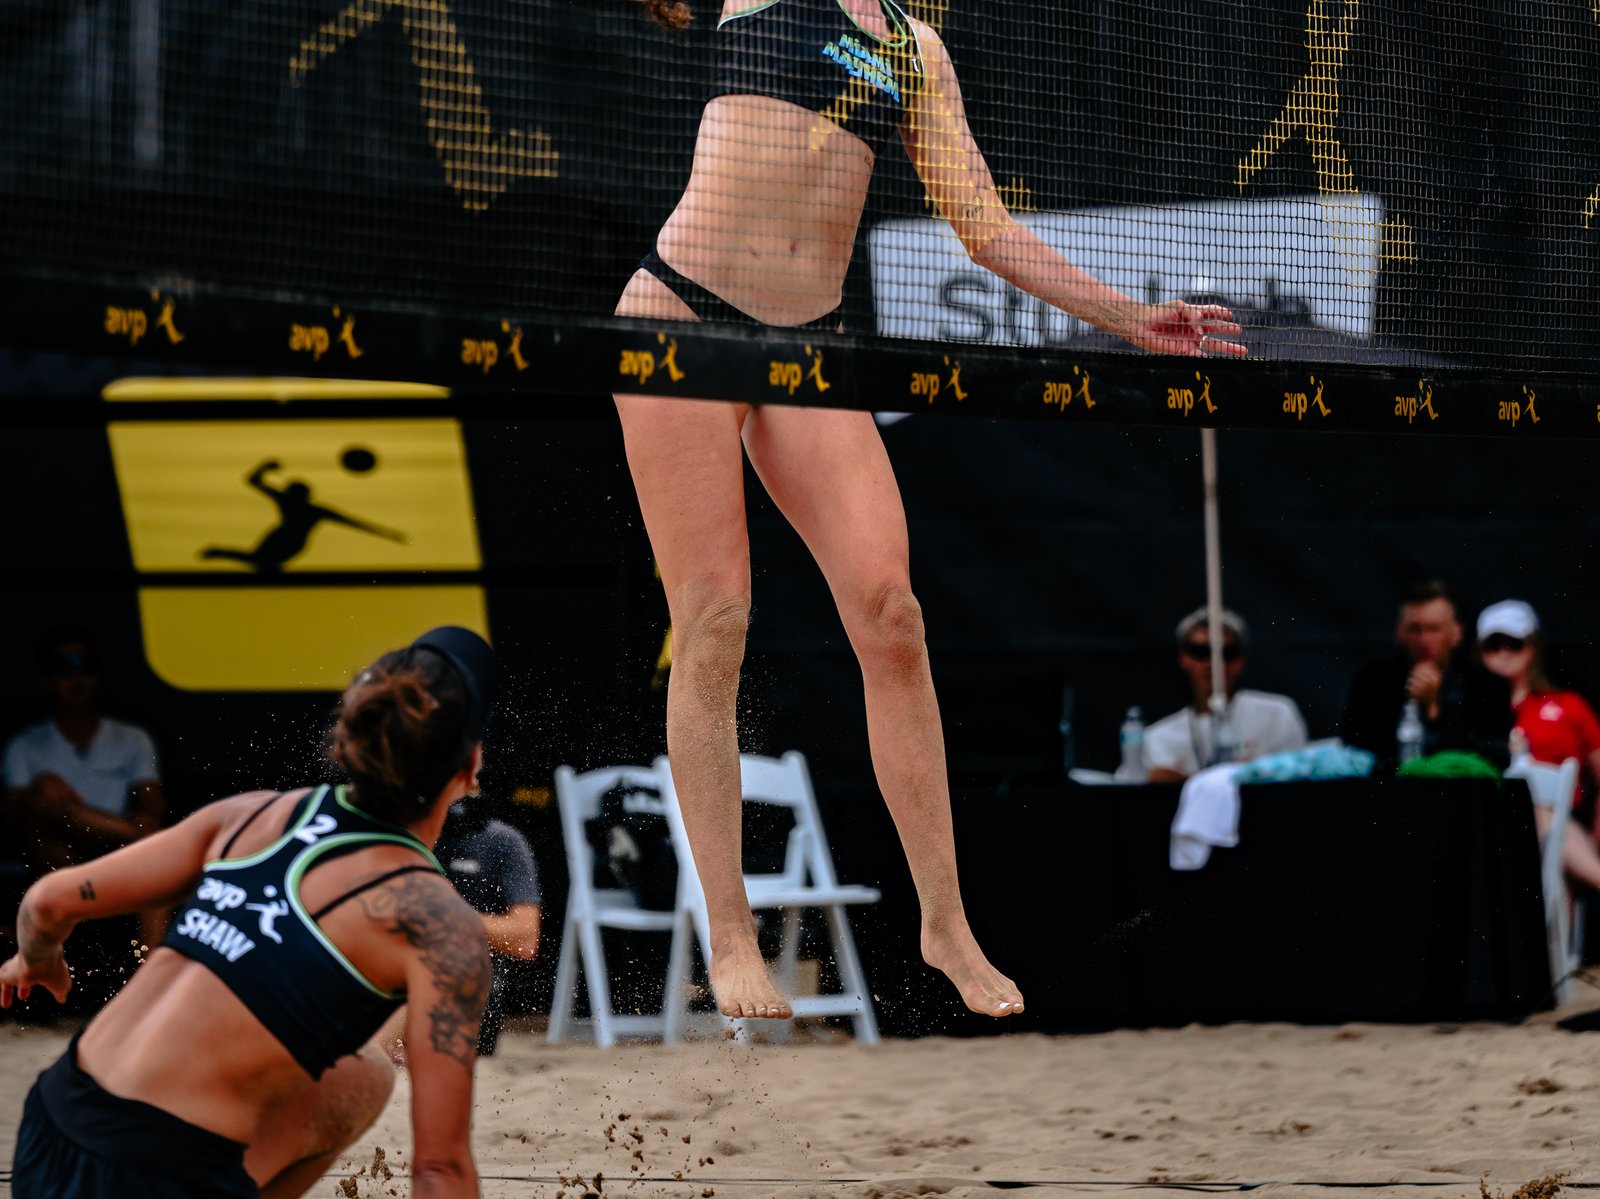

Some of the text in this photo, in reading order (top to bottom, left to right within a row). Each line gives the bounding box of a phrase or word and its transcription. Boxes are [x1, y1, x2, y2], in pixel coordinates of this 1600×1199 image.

[106, 307, 146, 343] avp
[290, 325, 329, 359] avp
[462, 339, 498, 373] avp
[619, 350, 655, 384] avp
[769, 361, 802, 395] avp
[910, 372, 940, 402] avp
[1043, 382, 1072, 411] avp
[1167, 387, 1194, 416] avp
[1282, 392, 1308, 420] avp
[1394, 396, 1417, 423] avp
[1498, 401, 1521, 427] avp
[295, 813, 338, 846] 2
[196, 877, 247, 911] avp
[176, 907, 256, 963] SHAW
